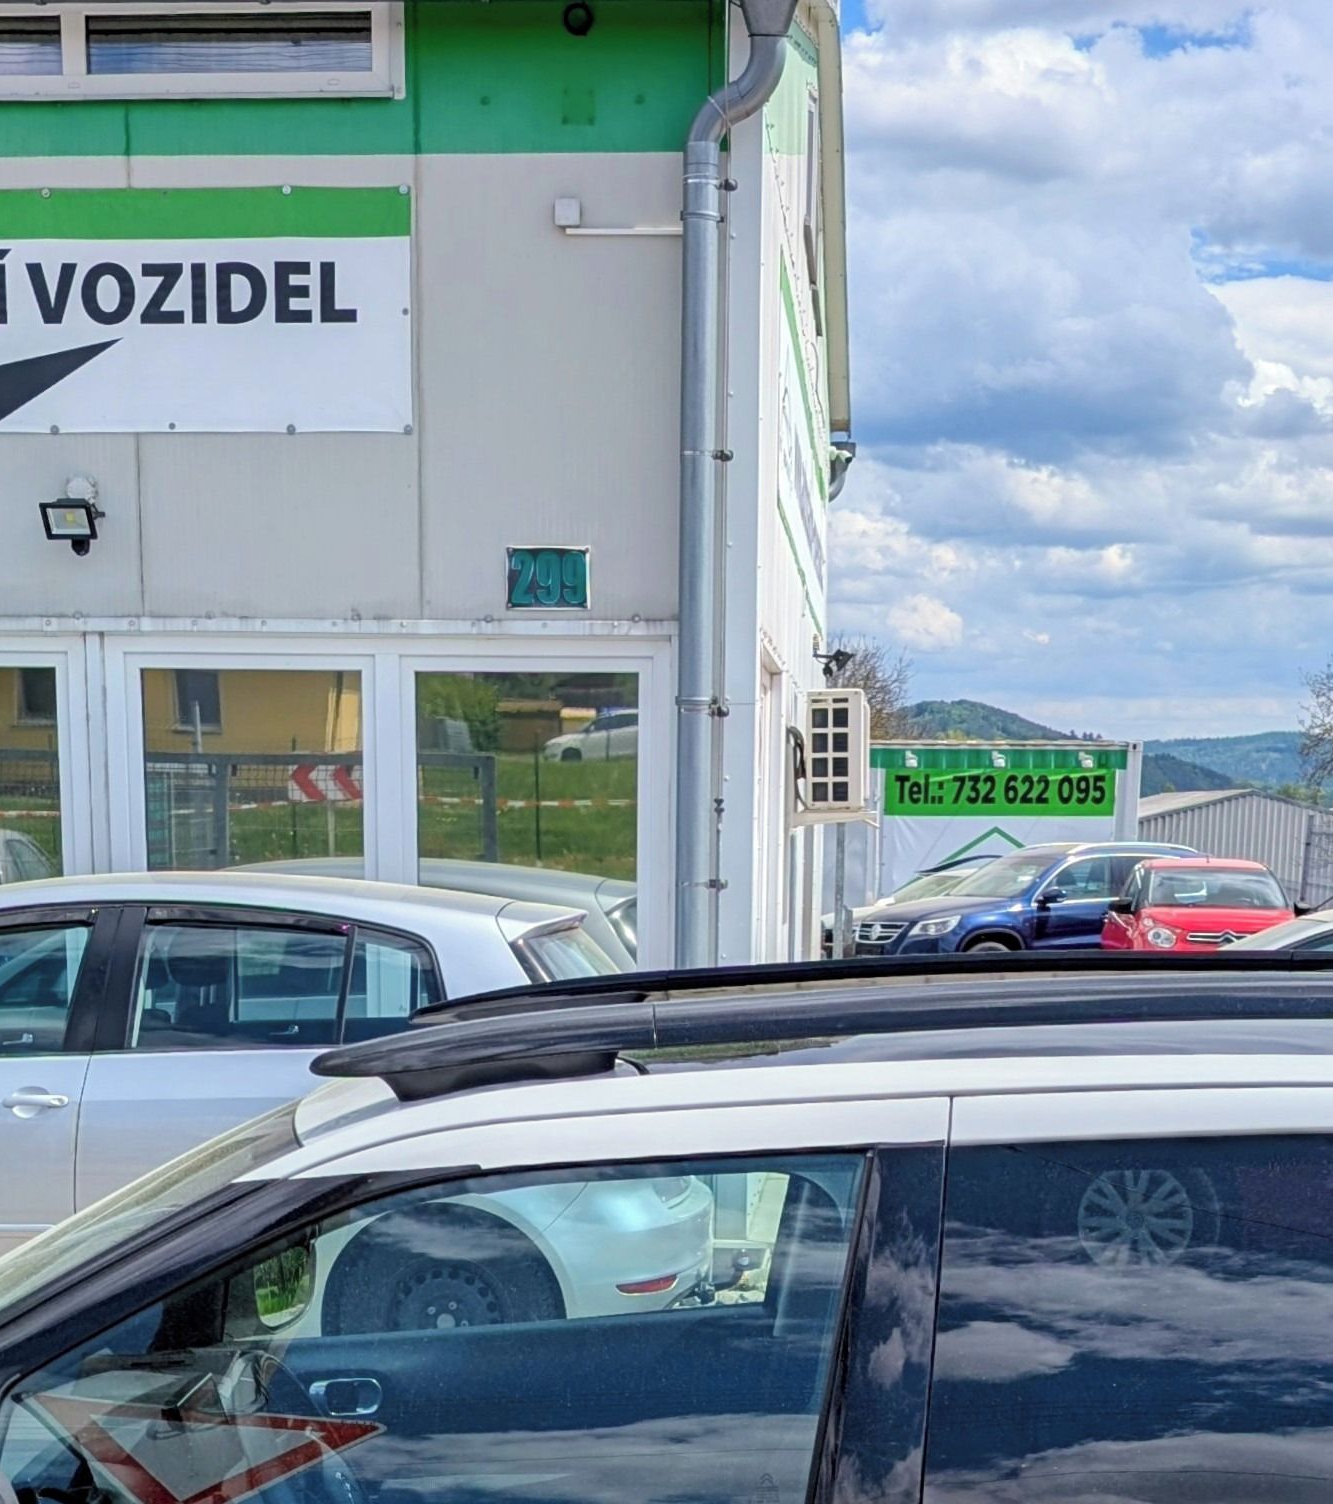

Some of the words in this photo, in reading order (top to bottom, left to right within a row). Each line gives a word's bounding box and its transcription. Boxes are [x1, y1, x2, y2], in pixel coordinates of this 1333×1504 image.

[25, 261, 357, 325] VOZIDEL
[510, 550, 587, 605] 299
[894, 774, 944, 805] Tel.:
[952, 774, 996, 805] 732
[1003, 774, 1050, 805] 622
[1057, 774, 1106, 805] 095
